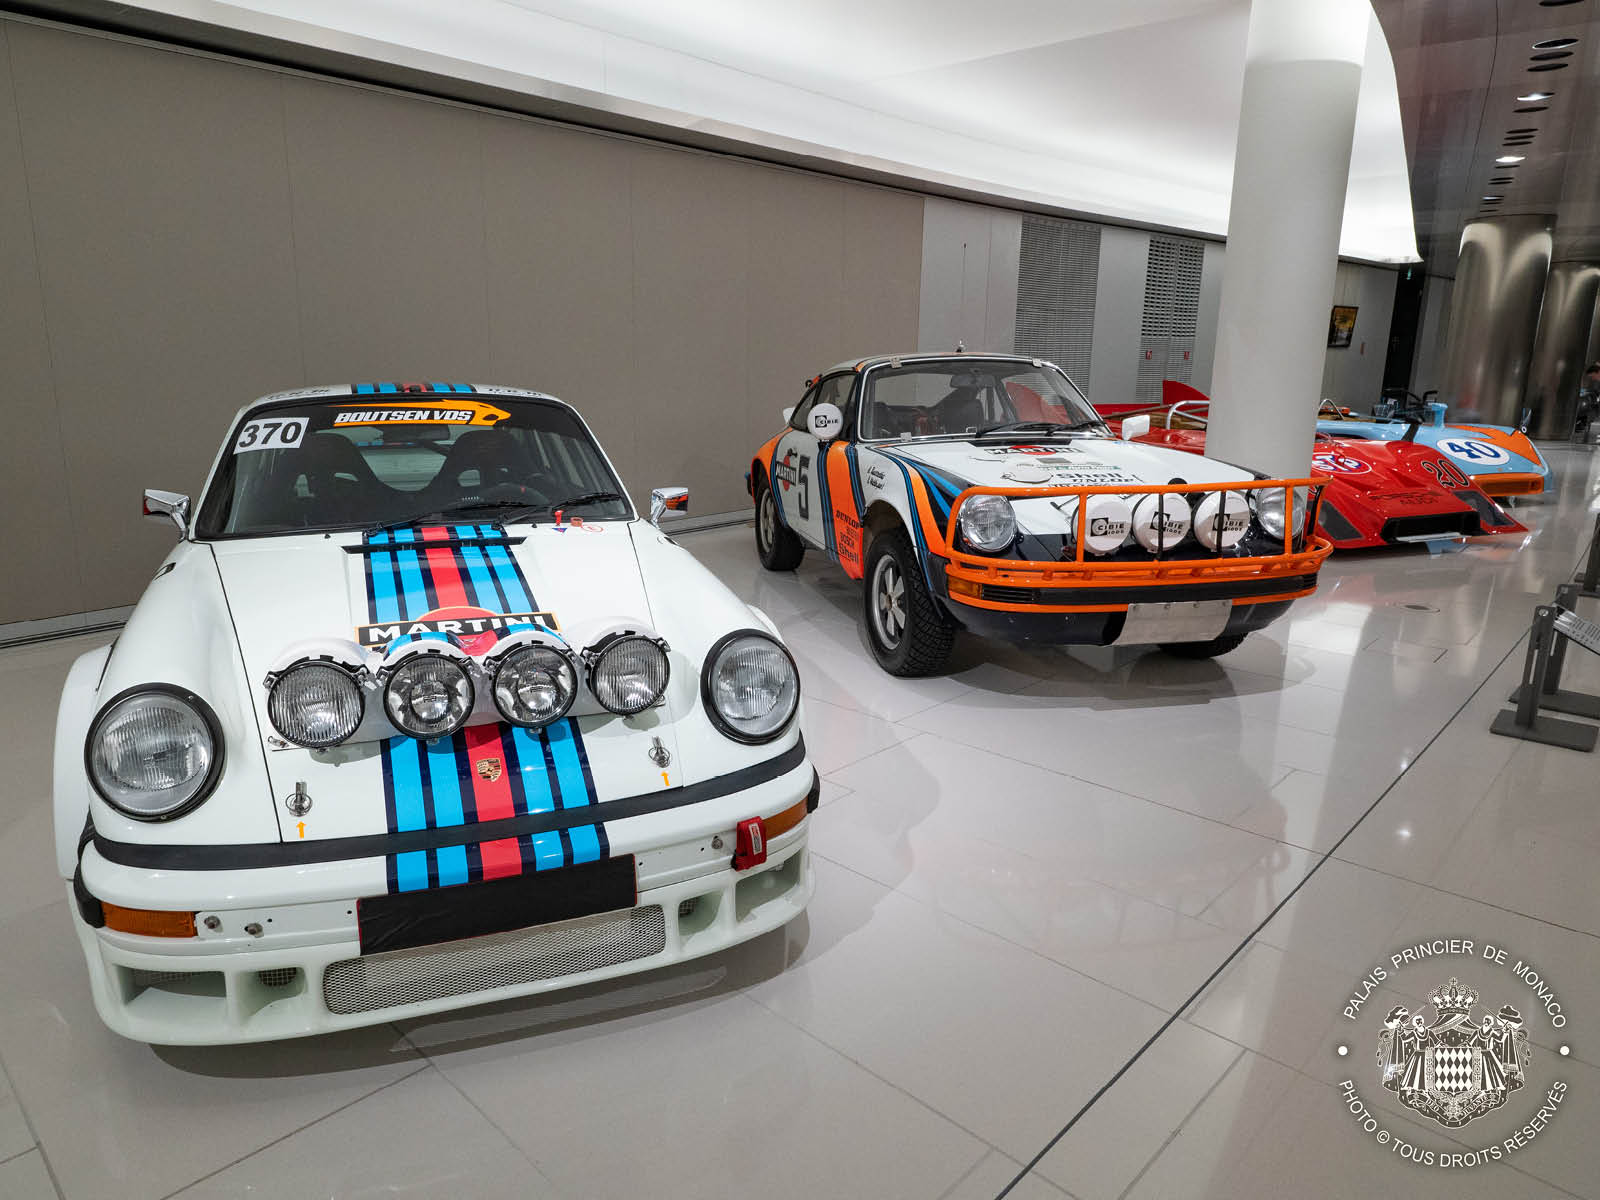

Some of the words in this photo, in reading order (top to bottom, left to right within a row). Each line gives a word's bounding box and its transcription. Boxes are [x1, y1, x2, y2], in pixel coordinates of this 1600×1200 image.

[335, 411, 430, 424] BOUTSEN
[433, 410, 472, 422] VOS
[238, 421, 302, 449] 370
[1447, 441, 1501, 459] 40
[798, 455, 811, 521] 5
[1421, 459, 1469, 489] 20
[1097, 523, 1125, 531] CIBIE
[368, 615, 546, 643] MARTINI
